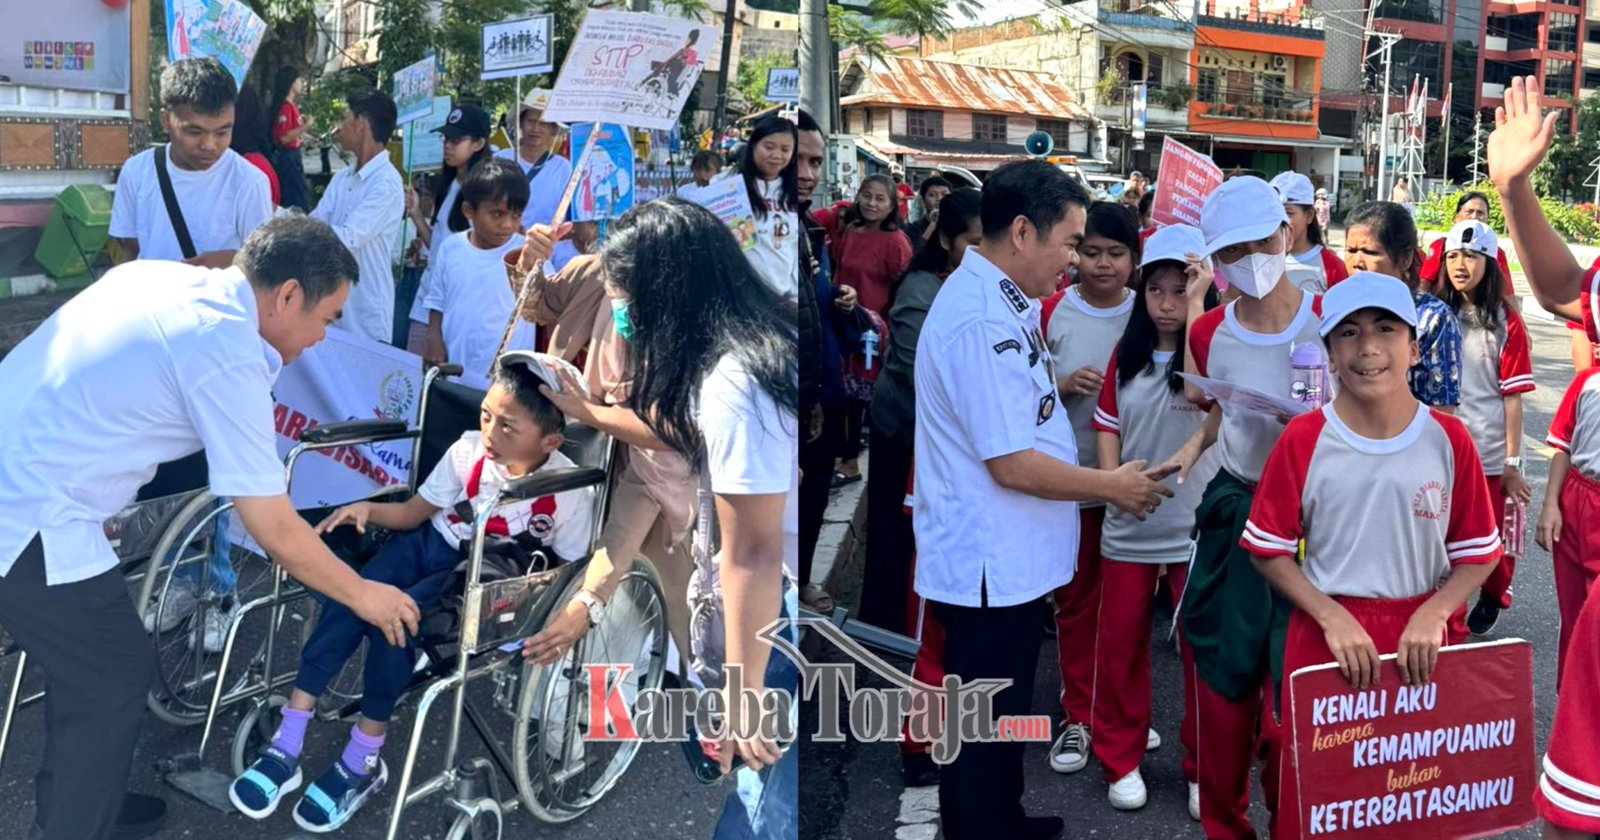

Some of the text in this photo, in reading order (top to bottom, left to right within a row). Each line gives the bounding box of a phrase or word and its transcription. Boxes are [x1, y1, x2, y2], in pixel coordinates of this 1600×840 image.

[1311, 682, 1438, 727] KENALI AKU
[1312, 721, 1375, 753] karena
[1353, 718, 1515, 768] KEMAMPUANKU
[1386, 761, 1442, 793] bukan
[1310, 776, 1514, 835] KETERBATASANKU
